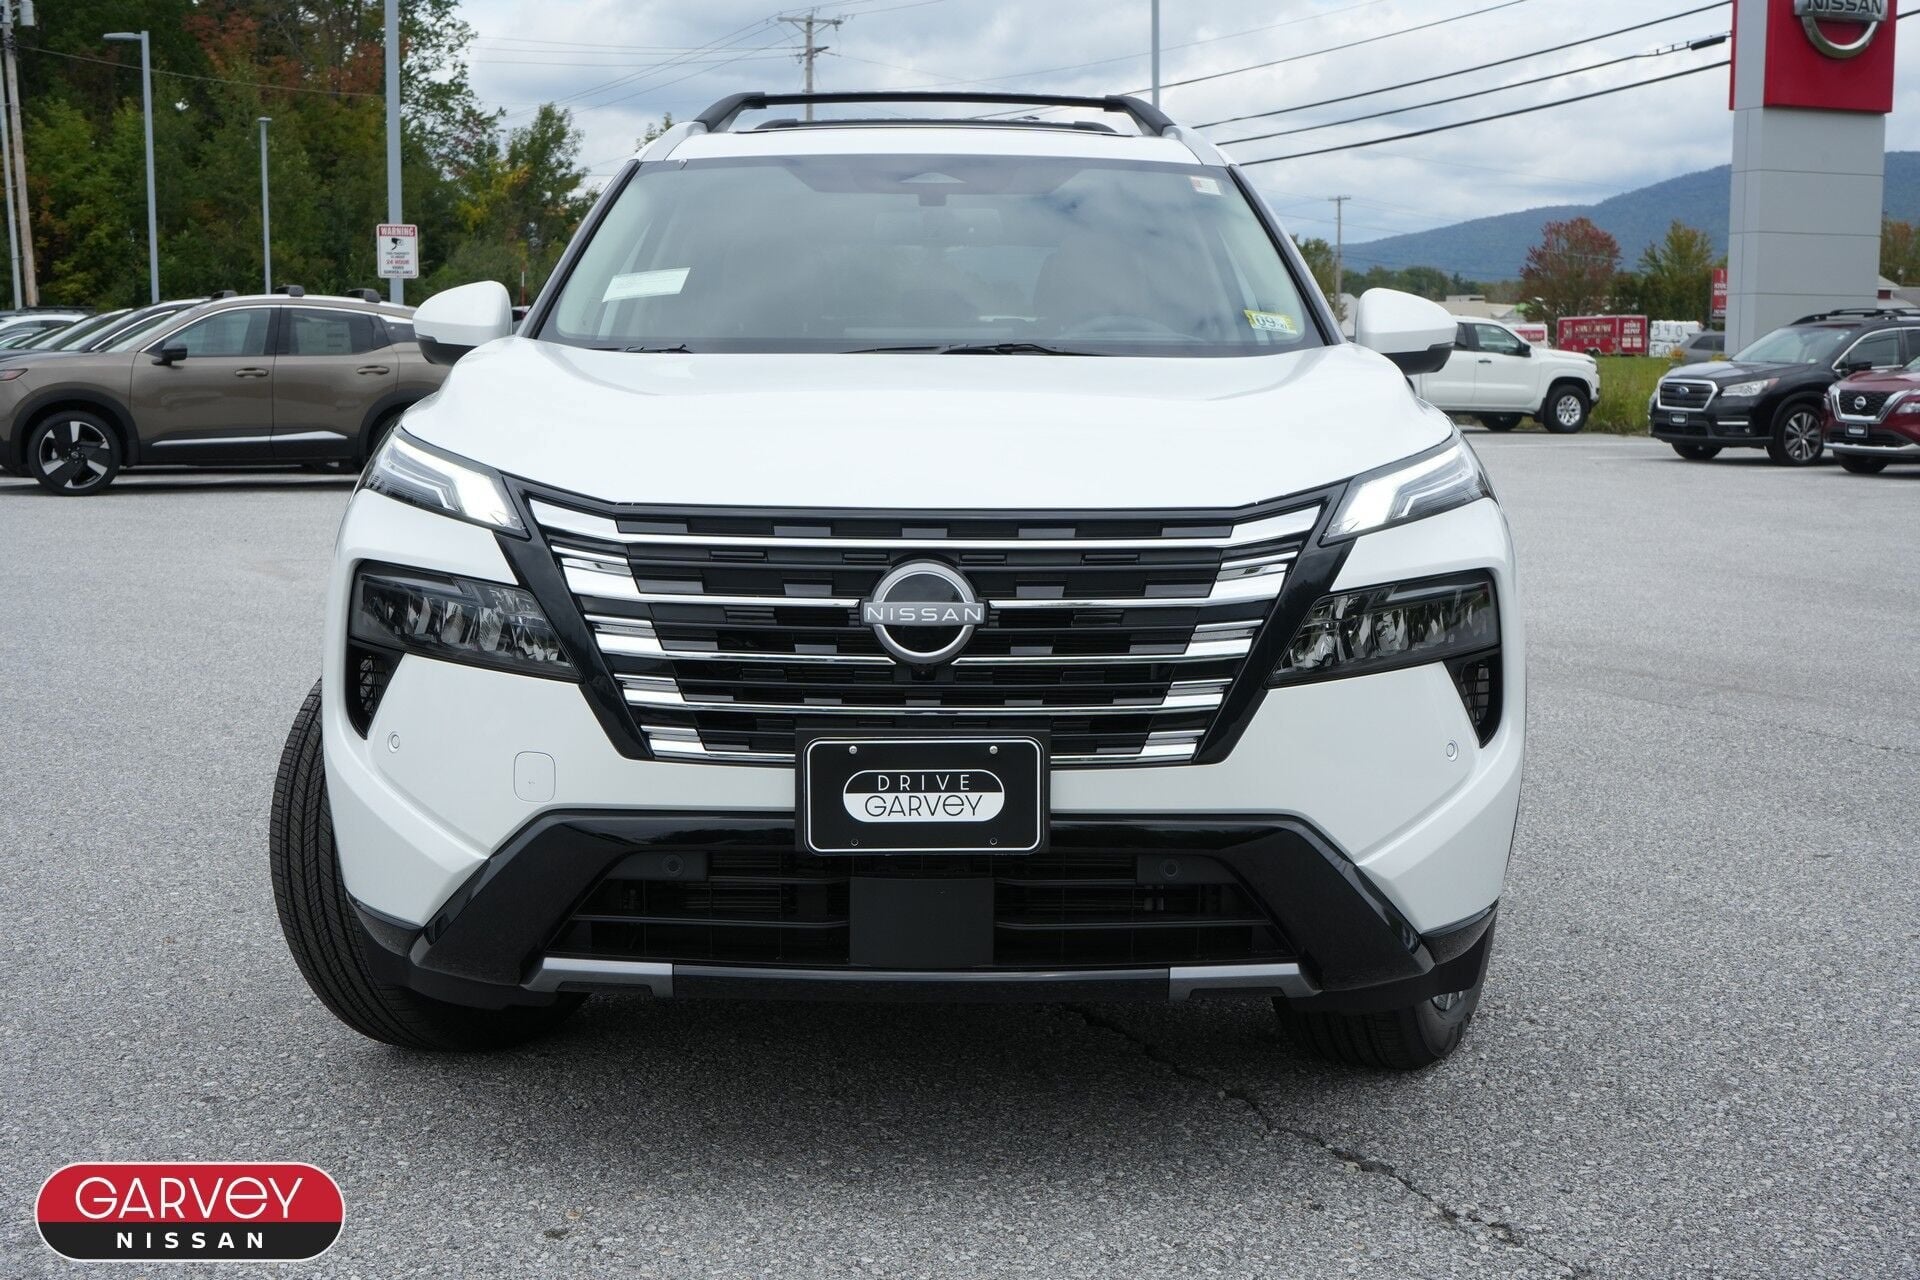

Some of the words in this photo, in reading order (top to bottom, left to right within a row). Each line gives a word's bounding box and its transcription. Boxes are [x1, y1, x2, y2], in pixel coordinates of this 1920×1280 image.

[1807, 0, 1883, 14] NISSAN
[380, 227, 414, 236] WARNING
[867, 606, 982, 621] NISSAN
[877, 774, 971, 791] DRIVE
